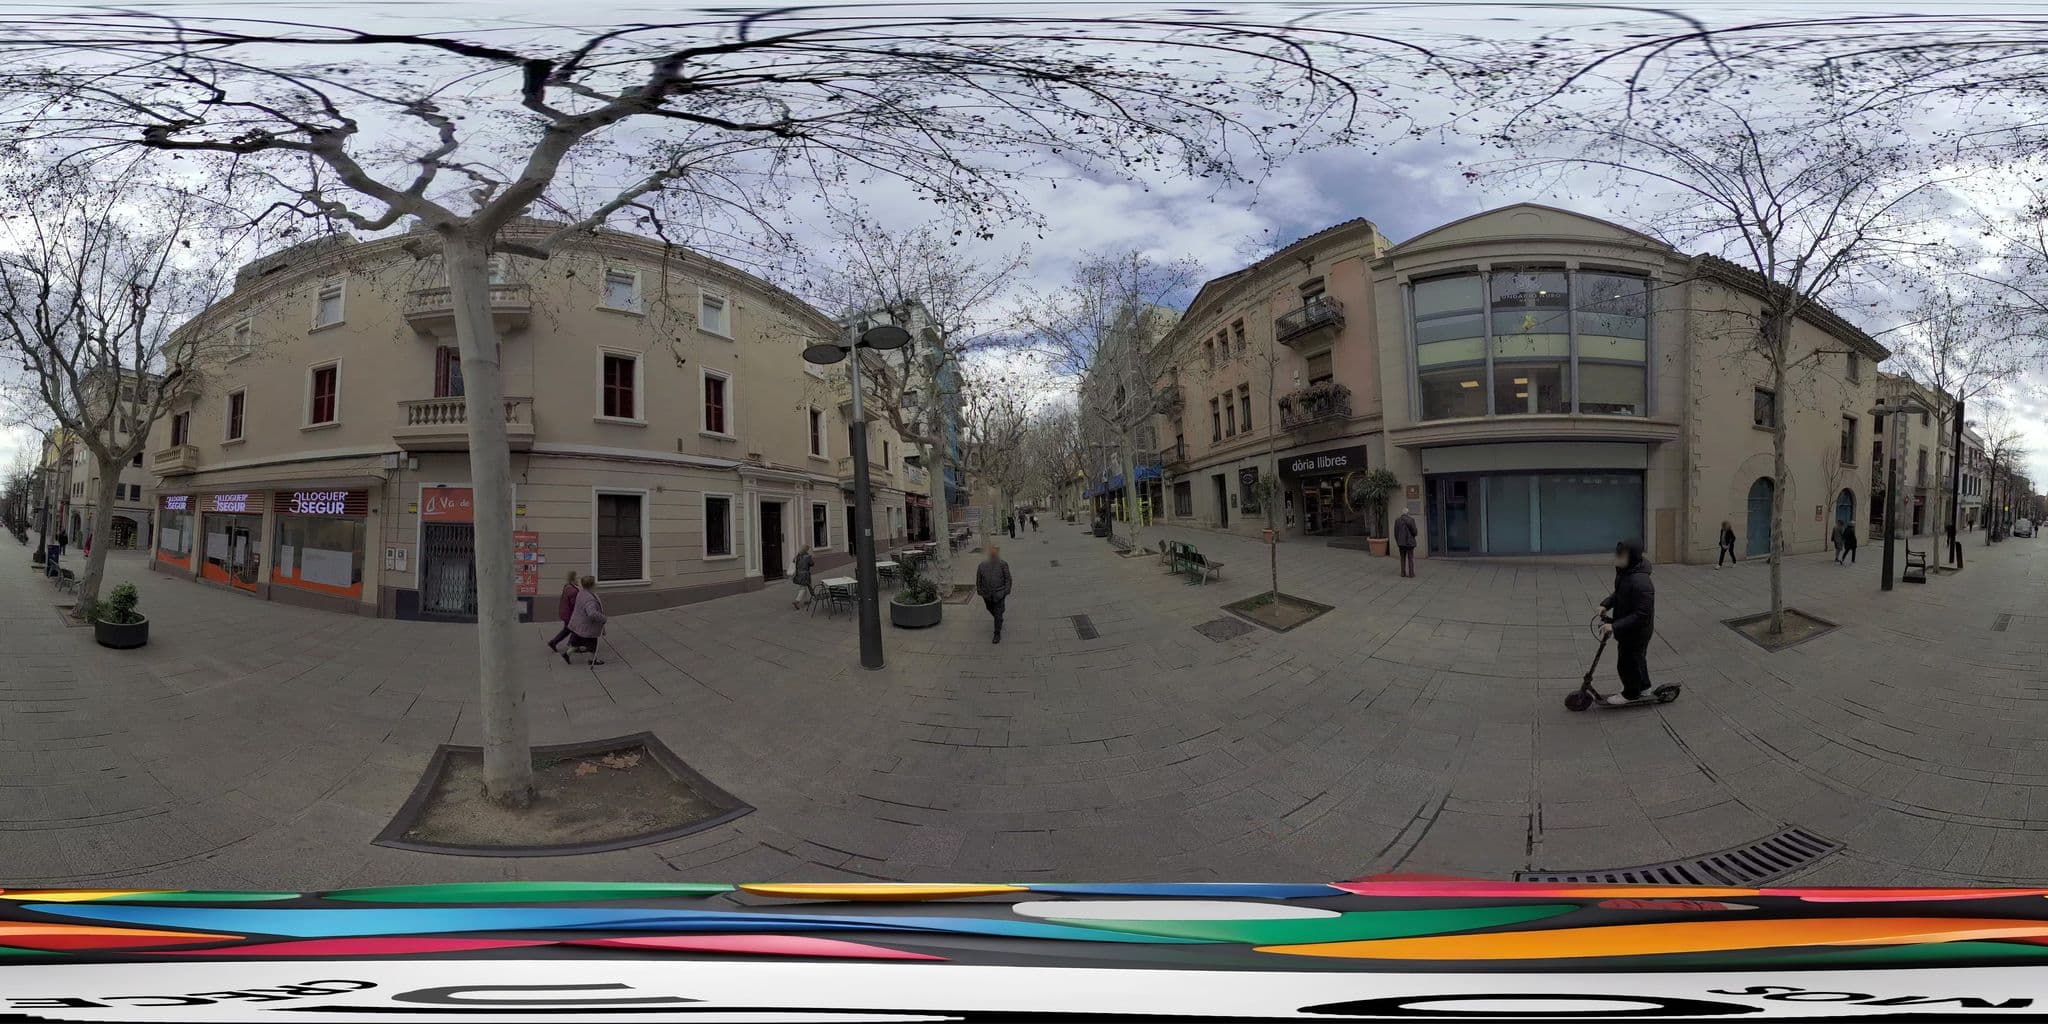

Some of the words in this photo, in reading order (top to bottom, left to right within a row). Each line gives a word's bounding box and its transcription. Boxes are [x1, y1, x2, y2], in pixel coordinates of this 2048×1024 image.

[1292, 458, 1315, 472] dòria
[1316, 455, 1348, 469] llibres
[168, 502, 187, 510] SEGUR
[219, 502, 246, 512] SEGUR
[302, 502, 345, 514] SEGUR
